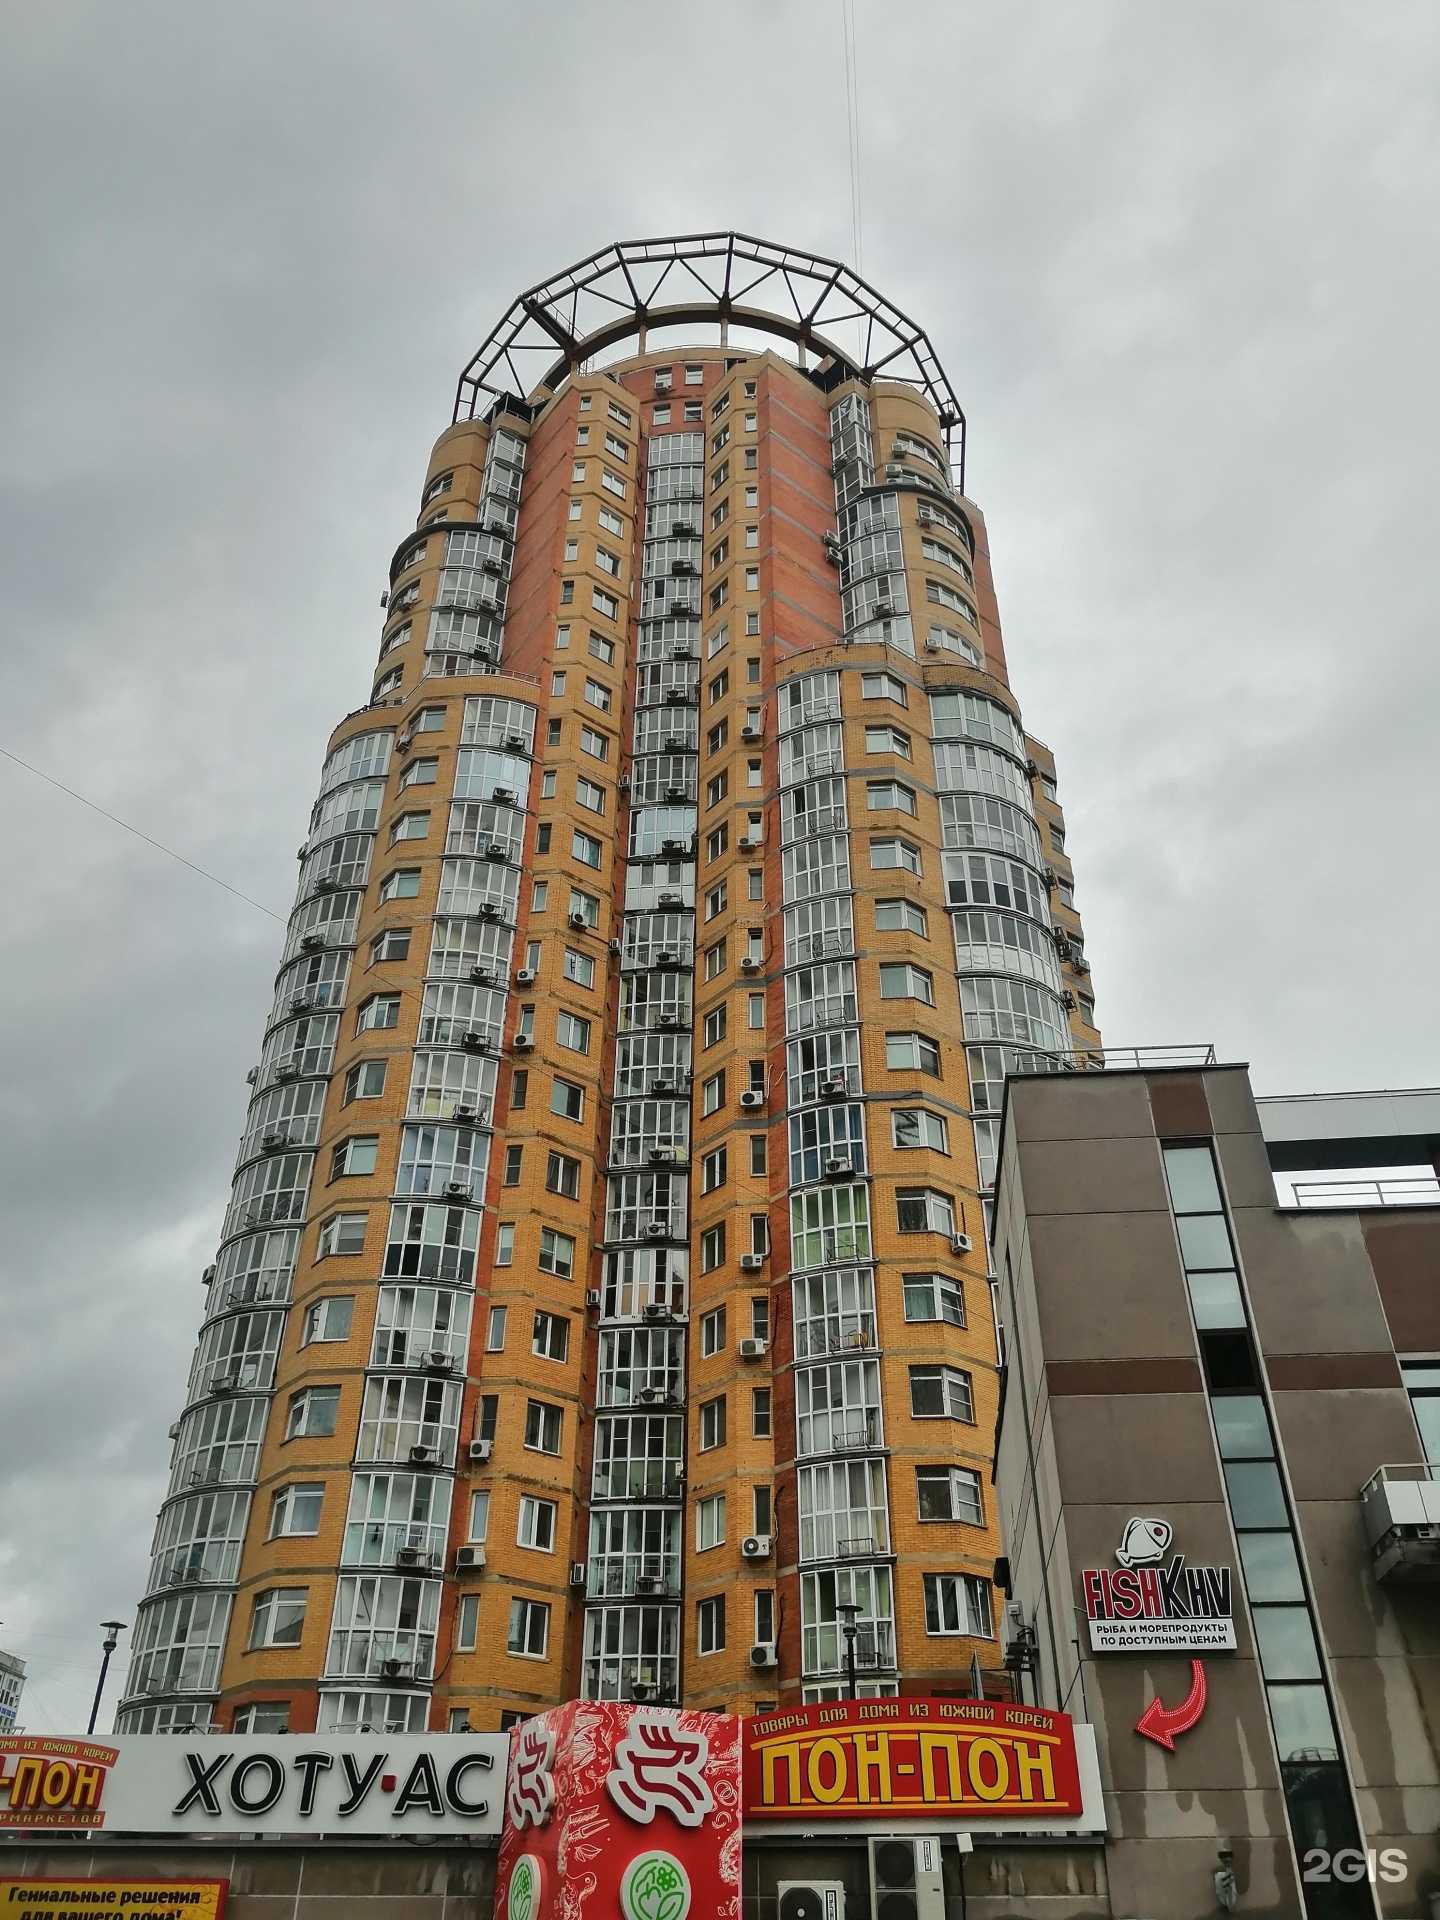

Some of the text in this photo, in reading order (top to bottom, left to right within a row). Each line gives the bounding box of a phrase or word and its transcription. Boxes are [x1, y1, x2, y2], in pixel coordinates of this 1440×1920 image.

[1082, 1554, 1232, 1619] FISHKHV
[1096, 1623, 1228, 1634] РЫБА И МОРЕПРОДУКТЫ
[1101, 1635, 1227, 1646] ПО ДОСТУПНЫМ ЦЕНАМ
[752, 1703, 1054, 1737] ТОВАРЫ ДЛЯ ДОМА ИЗ ЮЖНОЙ КОРЕИ
[24, 1740, 37, 1750] ИЗ
[761, 1731, 1056, 1804] ПОН-ПОН
[8, 1886, 201, 1906] Гениальные решения
